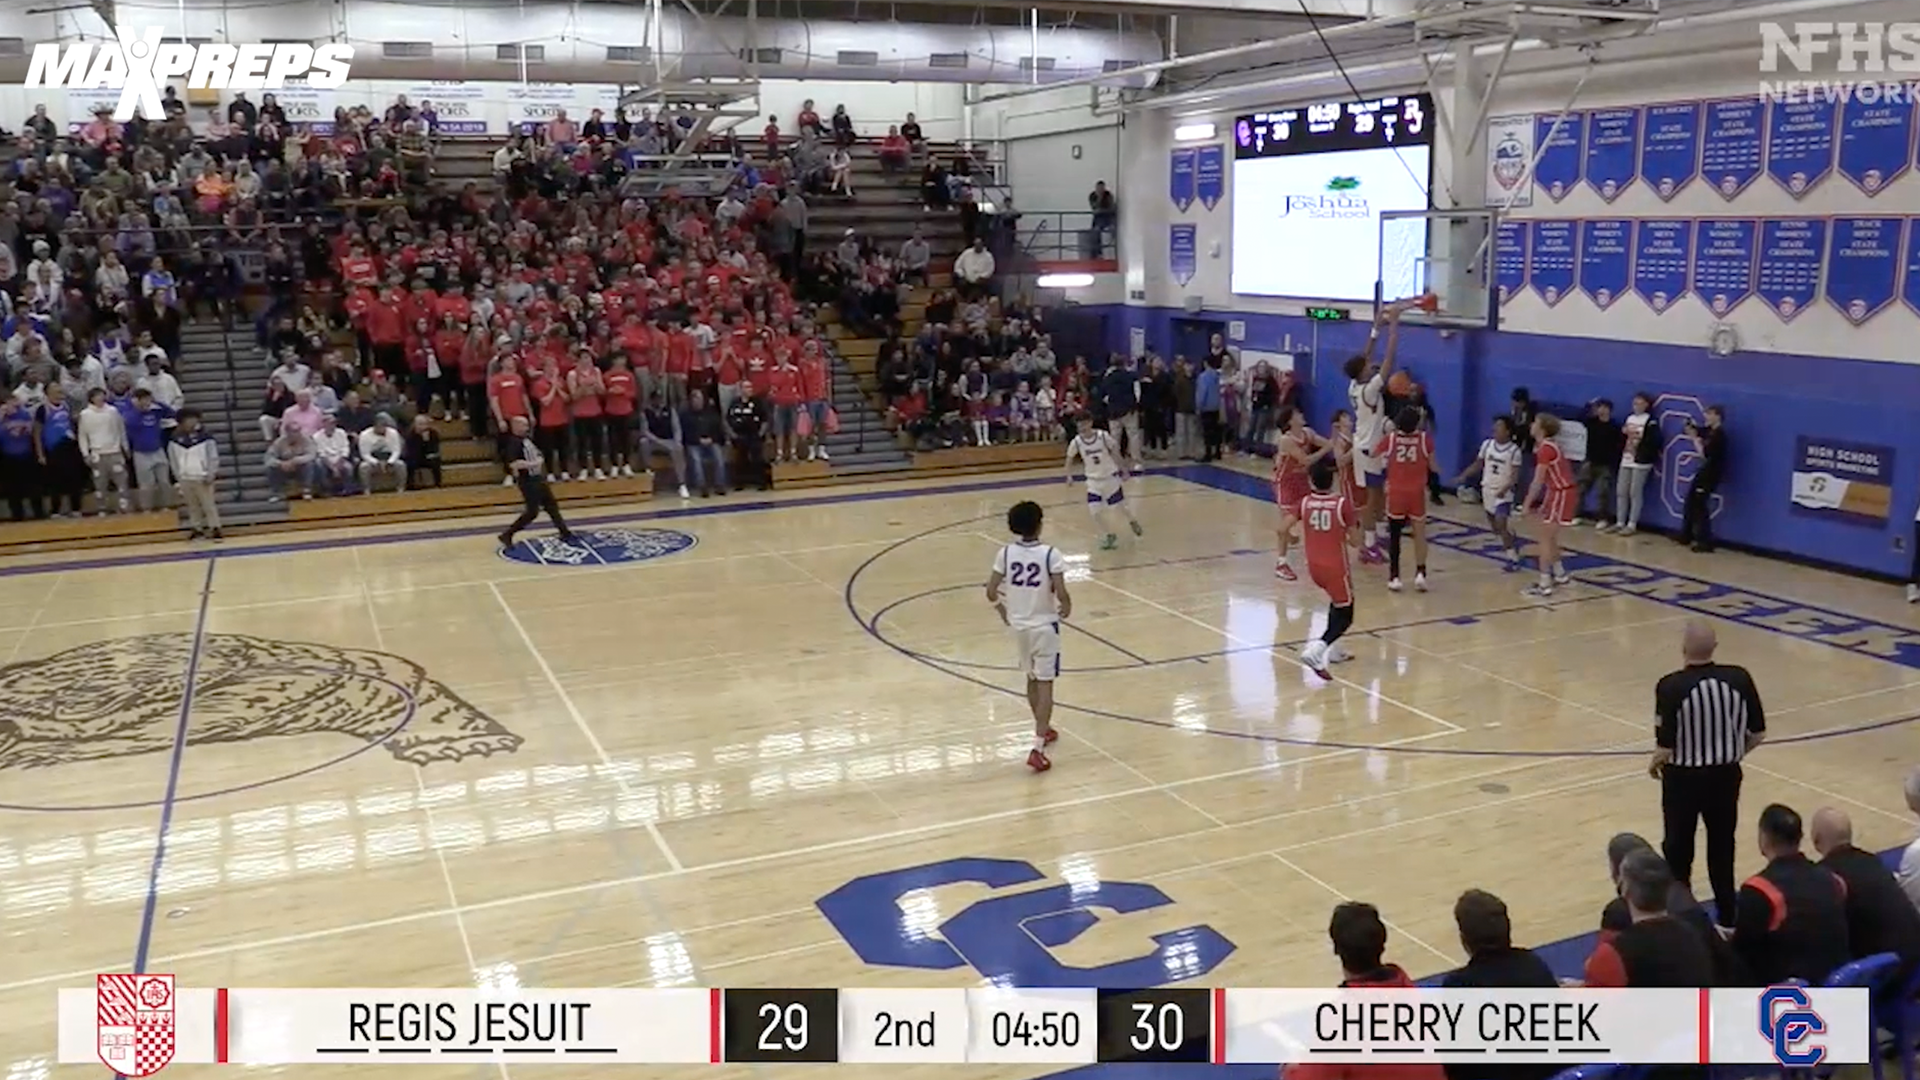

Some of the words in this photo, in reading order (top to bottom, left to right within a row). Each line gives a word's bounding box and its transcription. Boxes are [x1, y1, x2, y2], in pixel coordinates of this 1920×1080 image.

[1279, 195, 1369, 218] Joshua
[1309, 208, 1370, 218] School
[1396, 445, 1418, 463] 24
[1806, 445, 1834, 459] HIGH
[1836, 449, 1880, 466] SCHOOL
[1308, 509, 1333, 532] 40
[1010, 561, 1042, 588] 22
